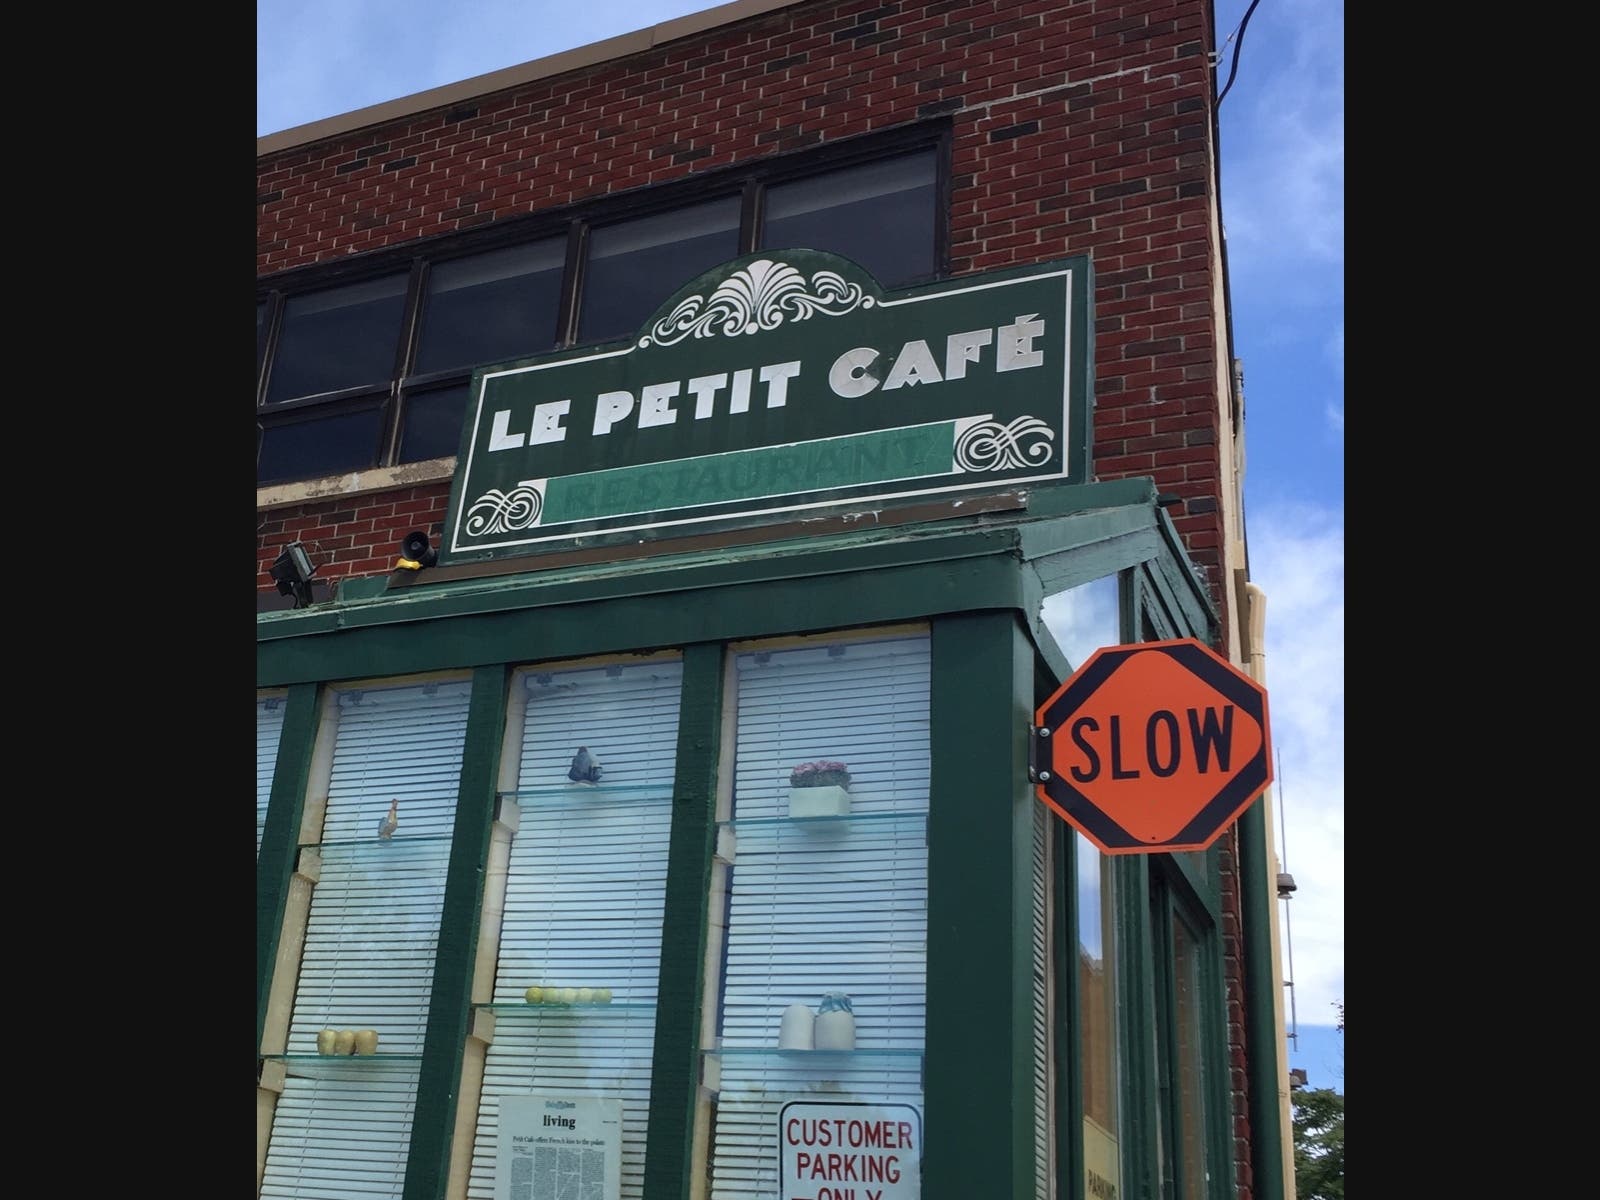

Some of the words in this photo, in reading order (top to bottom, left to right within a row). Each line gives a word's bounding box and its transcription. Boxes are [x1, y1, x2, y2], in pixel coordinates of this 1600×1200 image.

[488, 399, 571, 452] LE
[591, 360, 801, 437] PETIT
[828, 313, 1046, 399] CAFÉ
[563, 433, 932, 511] RESTAURANT
[1070, 705, 1234, 783] SLOW
[543, 1115, 576, 1130] living
[787, 1118, 913, 1149] CUSTOMER
[797, 1152, 901, 1184] PARKING
